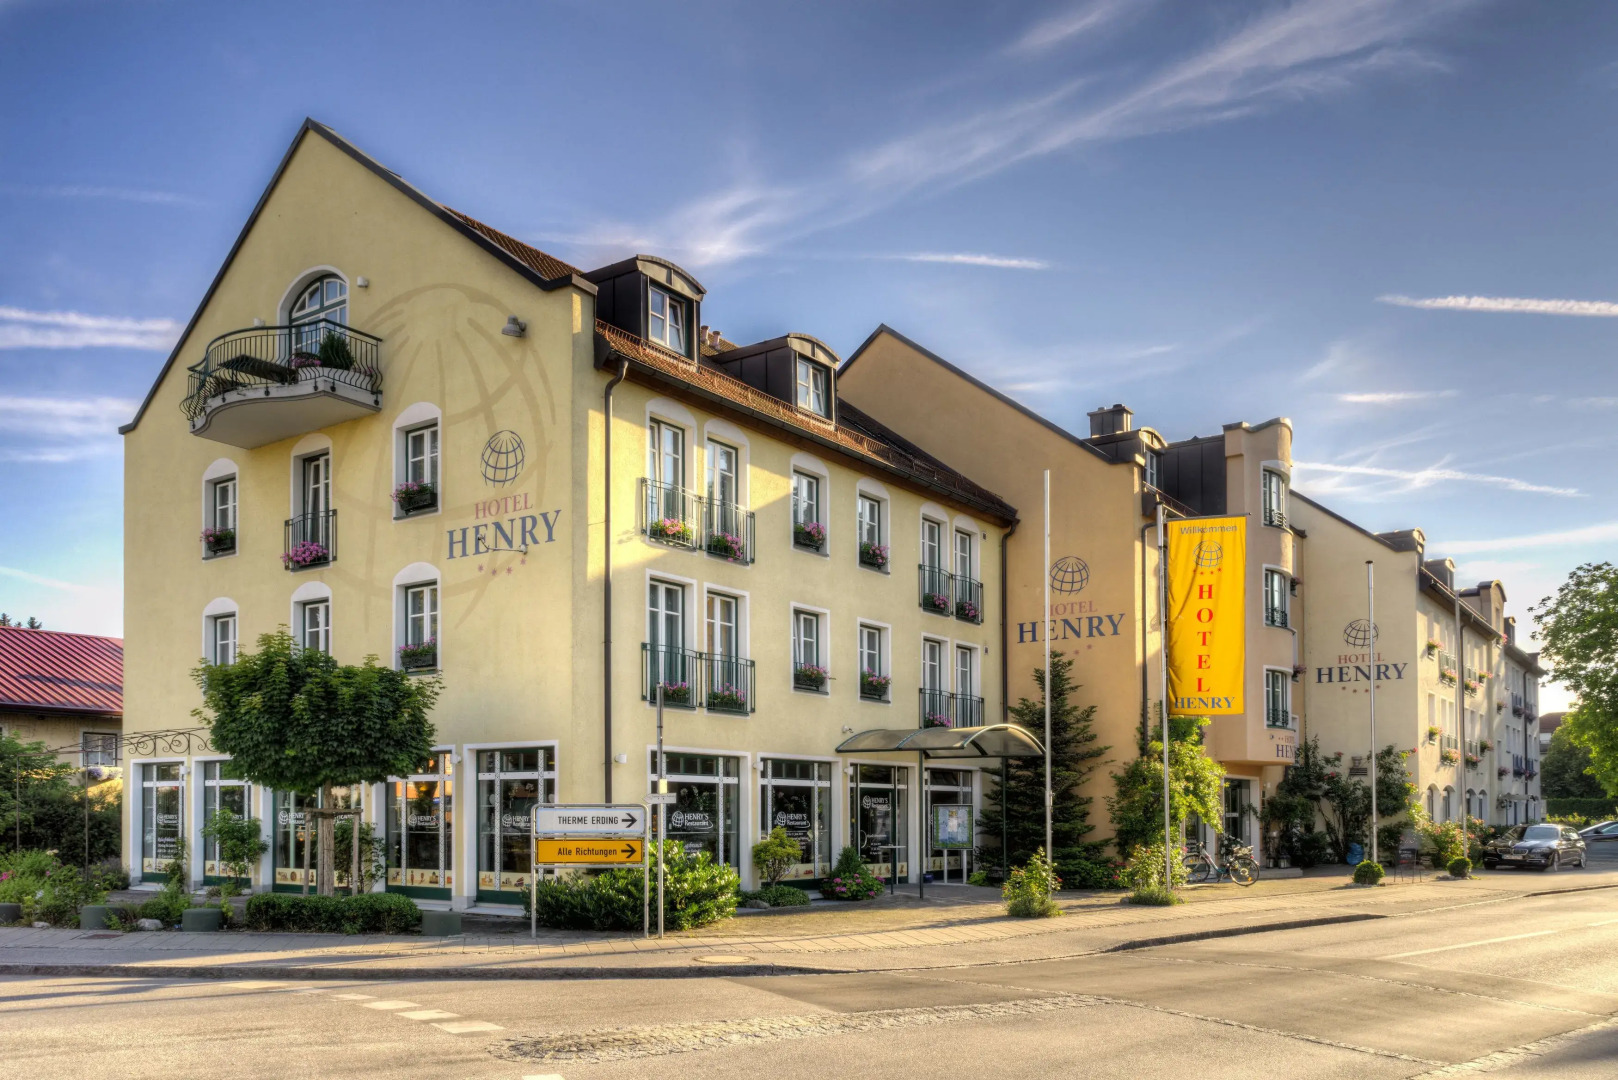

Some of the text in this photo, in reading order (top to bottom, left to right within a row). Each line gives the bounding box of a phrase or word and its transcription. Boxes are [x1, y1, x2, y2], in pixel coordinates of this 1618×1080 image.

[474, 493, 533, 520] HOTEL
[446, 509, 562, 560] HENRY
[1180, 525, 1237, 534] Willkommen
[1017, 613, 1125, 643] HENRY
[1196, 584, 1214, 692] HOTEL
[1316, 663, 1408, 683] HENRY
[1174, 696, 1235, 708] HENRY
[558, 816, 619, 825] THERME ERDING
[557, 847, 618, 858] Alle Richtungen
